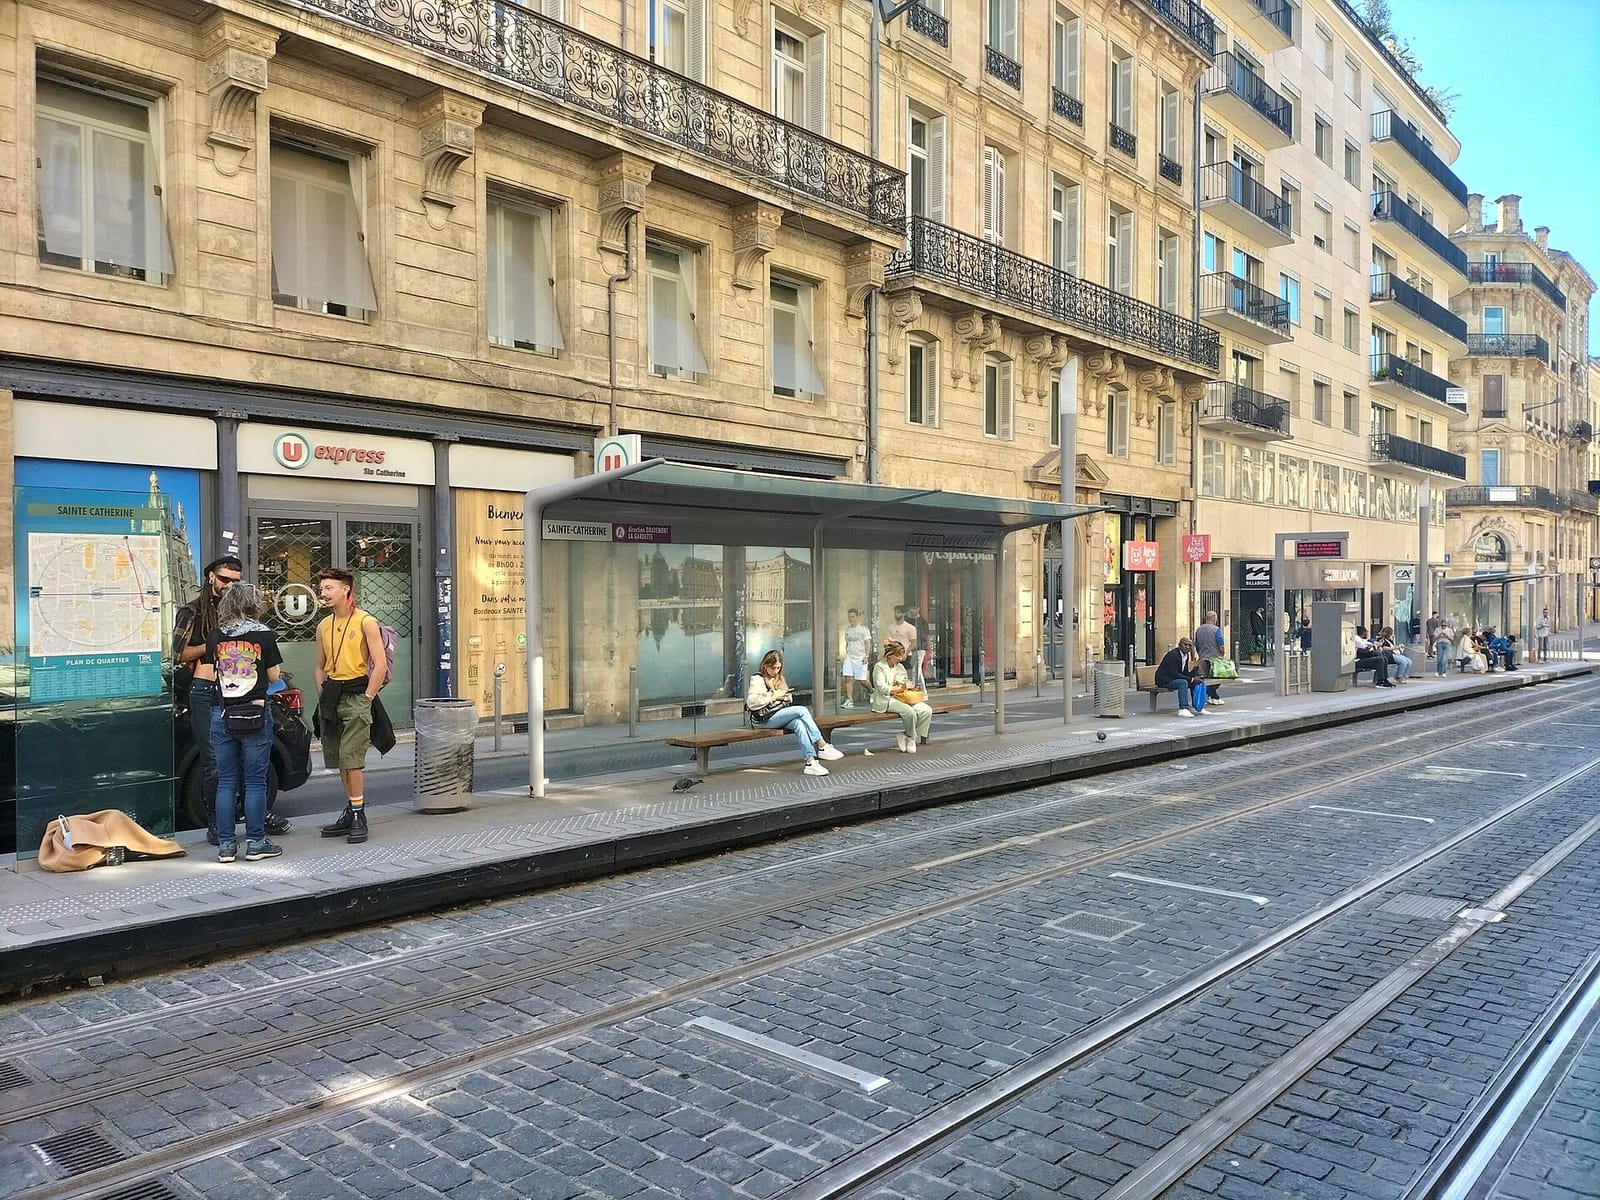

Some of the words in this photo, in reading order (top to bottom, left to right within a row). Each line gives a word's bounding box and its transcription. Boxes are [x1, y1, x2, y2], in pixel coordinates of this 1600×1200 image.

[283, 441, 302, 462] U
[314, 444, 386, 465] express
[376, 468, 406, 478] Catherine
[57, 505, 88, 517] SAINTE
[89, 507, 135, 518] CATHERINE
[546, 524, 608, 537] SAINTE-CATHERINE
[475, 536, 492, 546] Nous
[496, 561, 515, 569] 8h00
[481, 594, 498, 603] Dans
[500, 593, 517, 603] votre
[285, 594, 308, 616] U
[502, 607, 524, 615] SAINTE
[97, 657, 130, 665] QUARTIER
